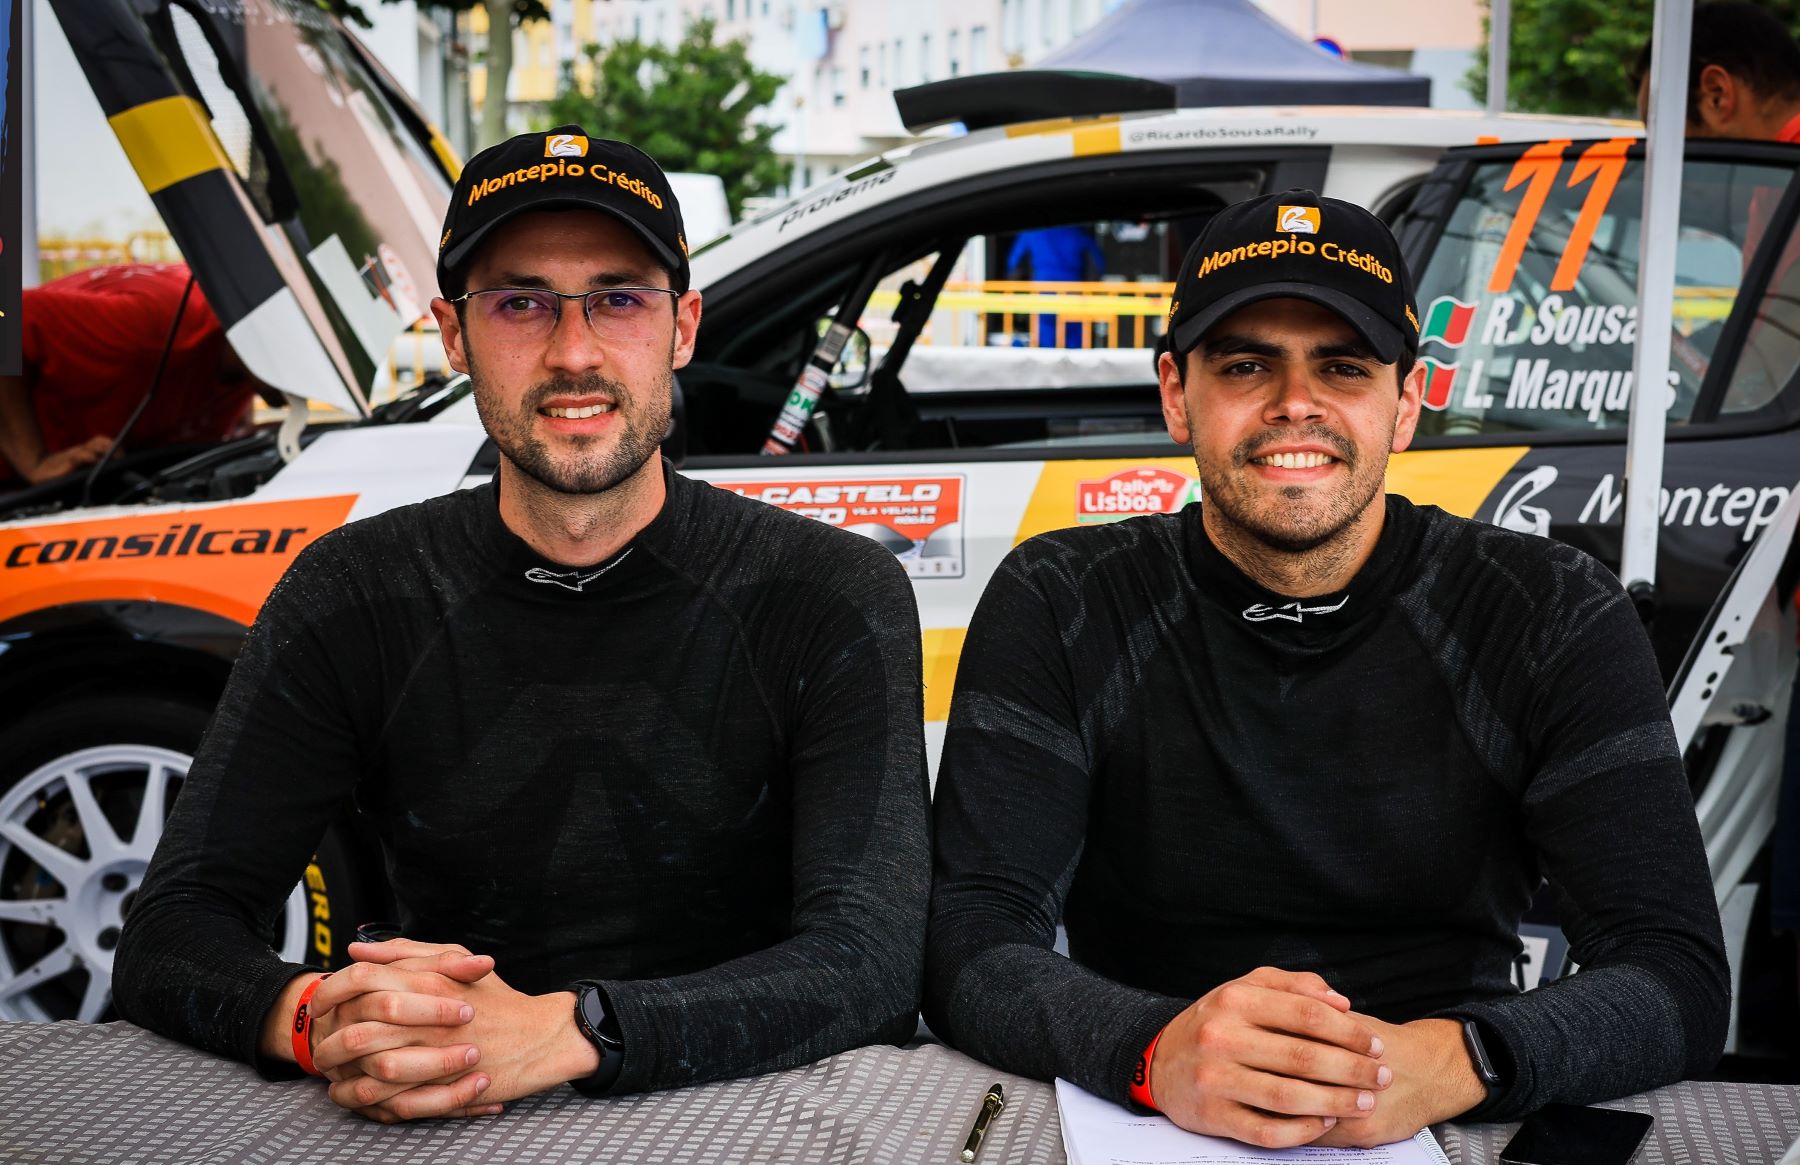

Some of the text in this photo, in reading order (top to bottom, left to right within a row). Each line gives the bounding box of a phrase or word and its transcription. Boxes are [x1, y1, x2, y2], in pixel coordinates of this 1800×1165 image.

[467, 158, 664, 210] Montepio Crédito
[1487, 137, 1637, 293] 11
[1198, 234, 1393, 284] Montepio Crédito
[1480, 296, 1525, 346] R.
[1462, 358, 1680, 422] L. Marqus
[1083, 491, 1162, 512] Lisboa
[1109, 479, 1153, 497] Rally
[1577, 473, 1791, 542] Mntep
[4, 523, 308, 569] consilcar
[305, 855, 332, 956] ERO
